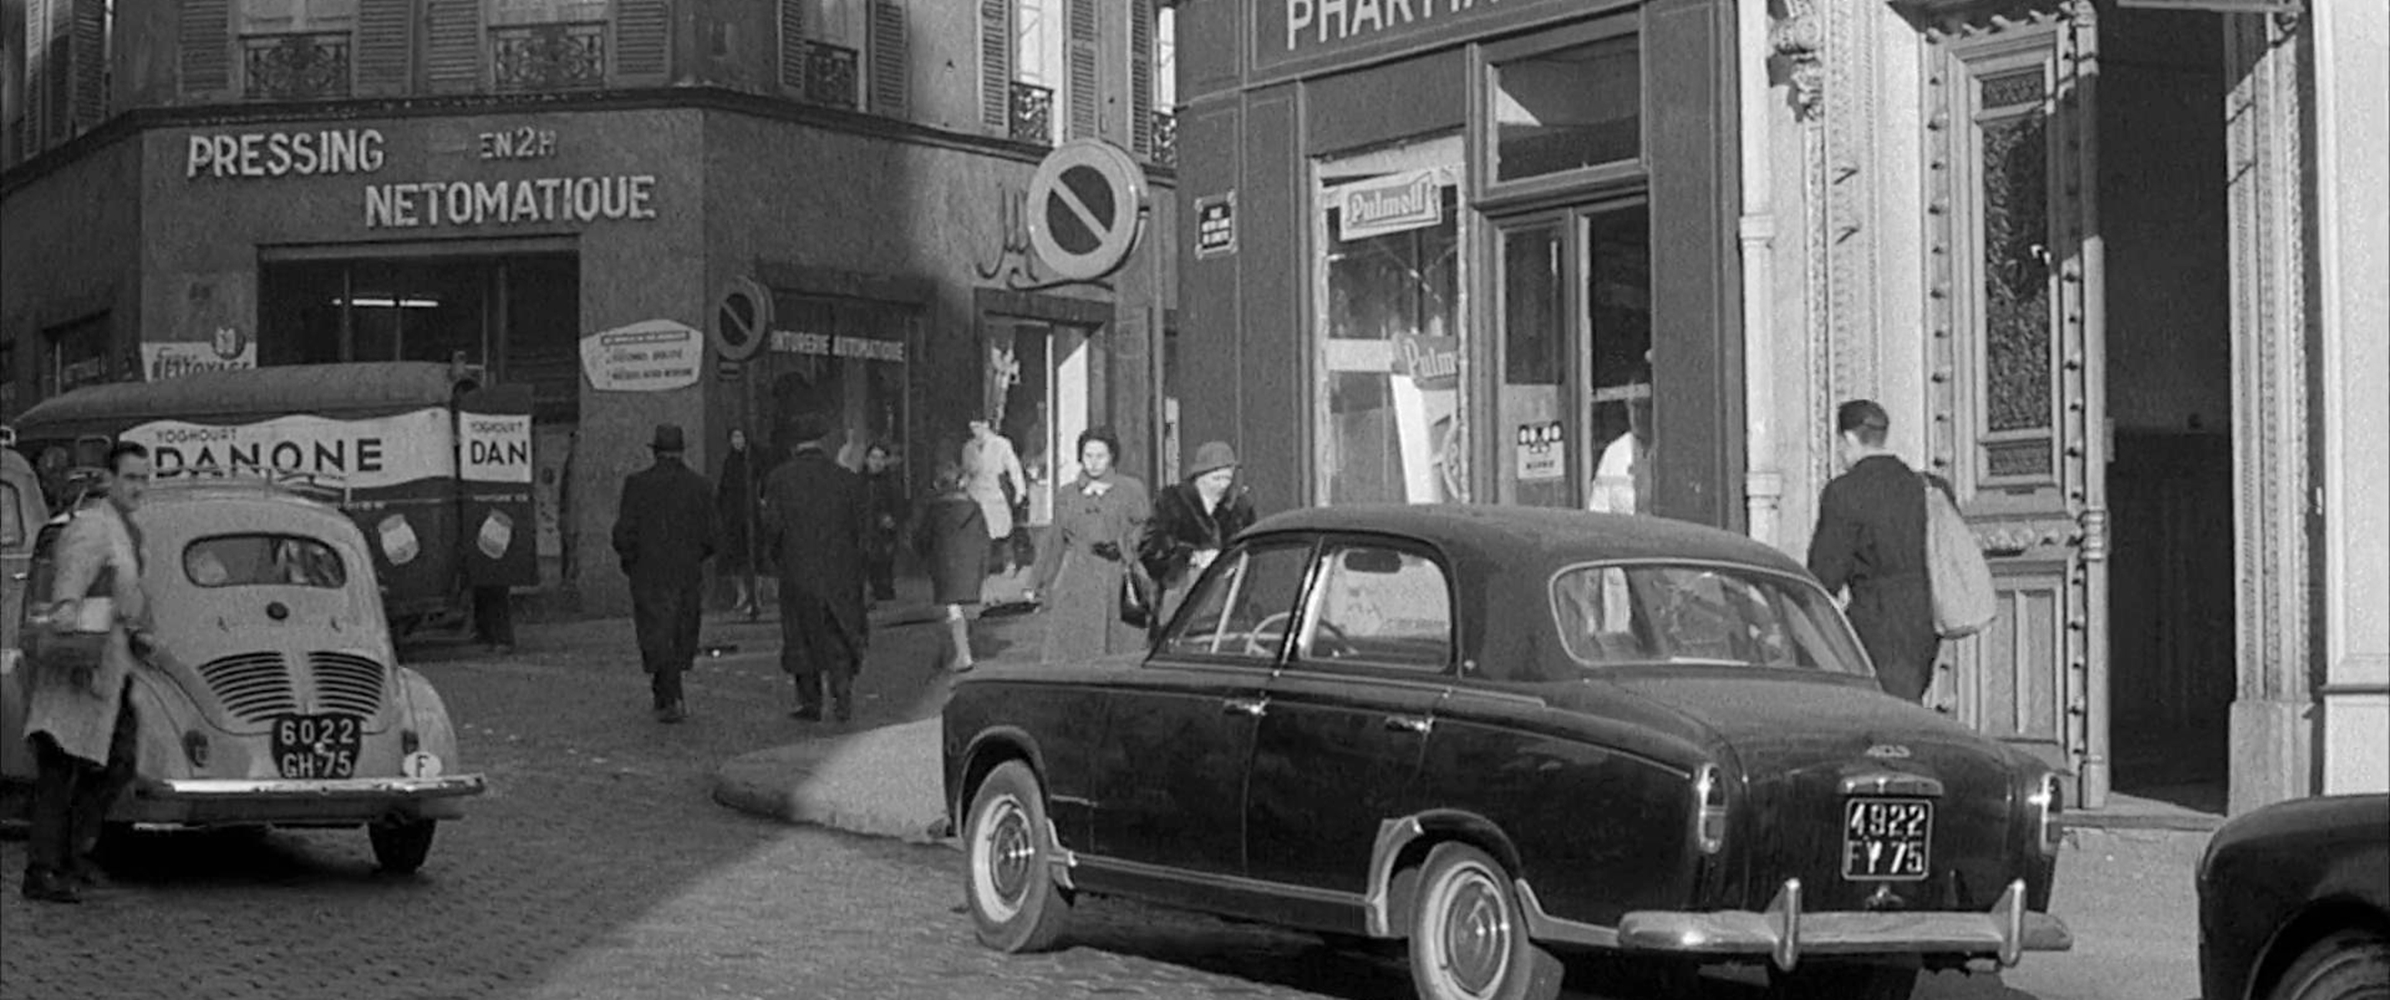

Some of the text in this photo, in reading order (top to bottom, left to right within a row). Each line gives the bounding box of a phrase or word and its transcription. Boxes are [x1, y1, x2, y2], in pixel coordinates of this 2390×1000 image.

[187, 129, 384, 178] PRESSING
[365, 175, 657, 228] NETOMATIQUE
[155, 438, 382, 478] DANONE
[470, 440, 527, 465] DAN
[281, 718, 355, 745] 6022
[416, 754, 430, 777] F
[1851, 803, 1926, 836] 4922
[1890, 840, 1923, 873] 75
